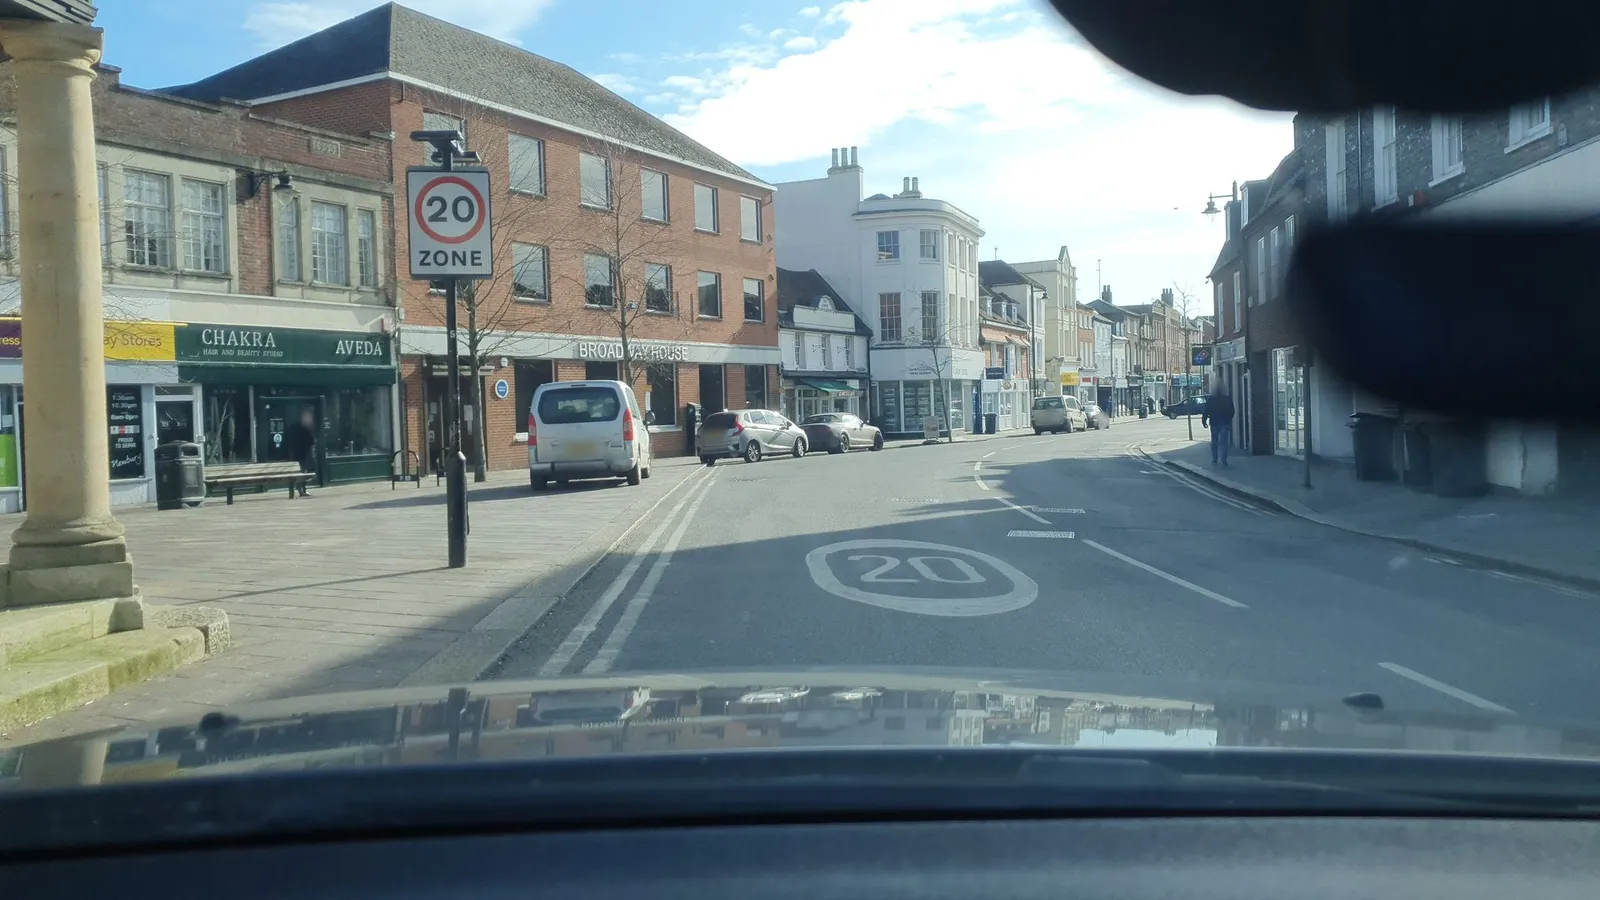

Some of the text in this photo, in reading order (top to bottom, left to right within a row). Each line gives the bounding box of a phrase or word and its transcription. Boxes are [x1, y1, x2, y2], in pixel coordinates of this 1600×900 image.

[426, 195, 475, 223] 20
[418, 249, 483, 267] ZONE
[121, 333, 162, 347] Stores
[201, 328, 277, 348] CHAKRA
[202, 348, 219, 356] HAIR
[237, 349, 260, 357] BEAUTY
[335, 339, 383, 356] AVEDA
[651, 345, 689, 361] HOUSE
[848, 554, 987, 584] 20
